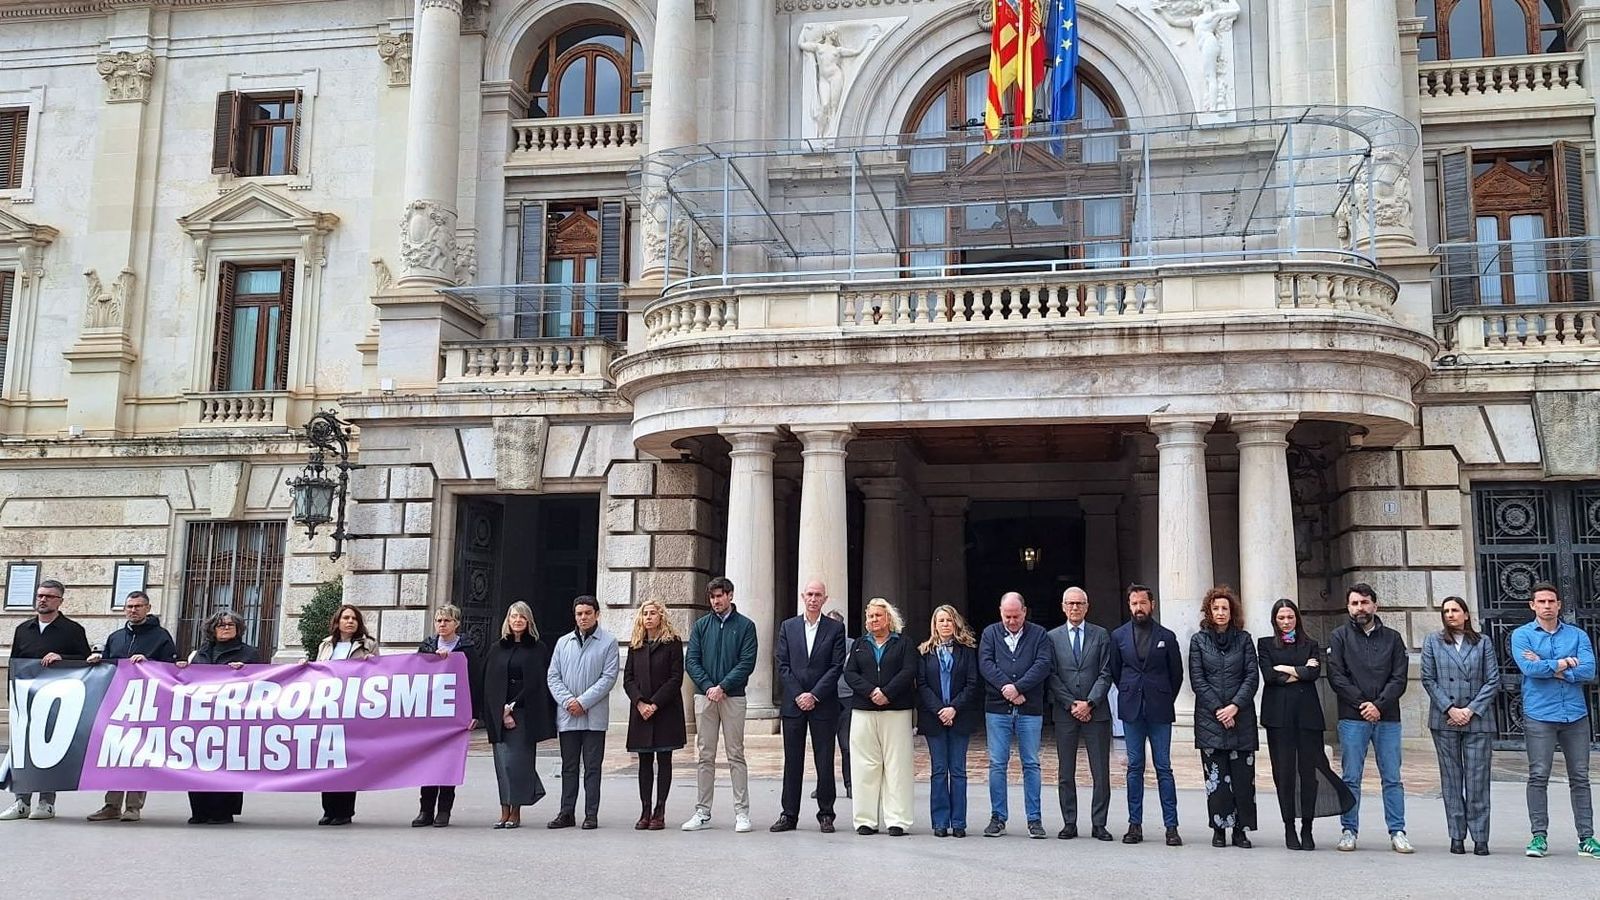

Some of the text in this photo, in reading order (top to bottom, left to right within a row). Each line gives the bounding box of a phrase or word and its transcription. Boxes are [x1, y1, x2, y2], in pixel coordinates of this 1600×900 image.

[111, 674, 456, 721] AL TERRORISME
[97, 724, 347, 770] MASCLISTA
